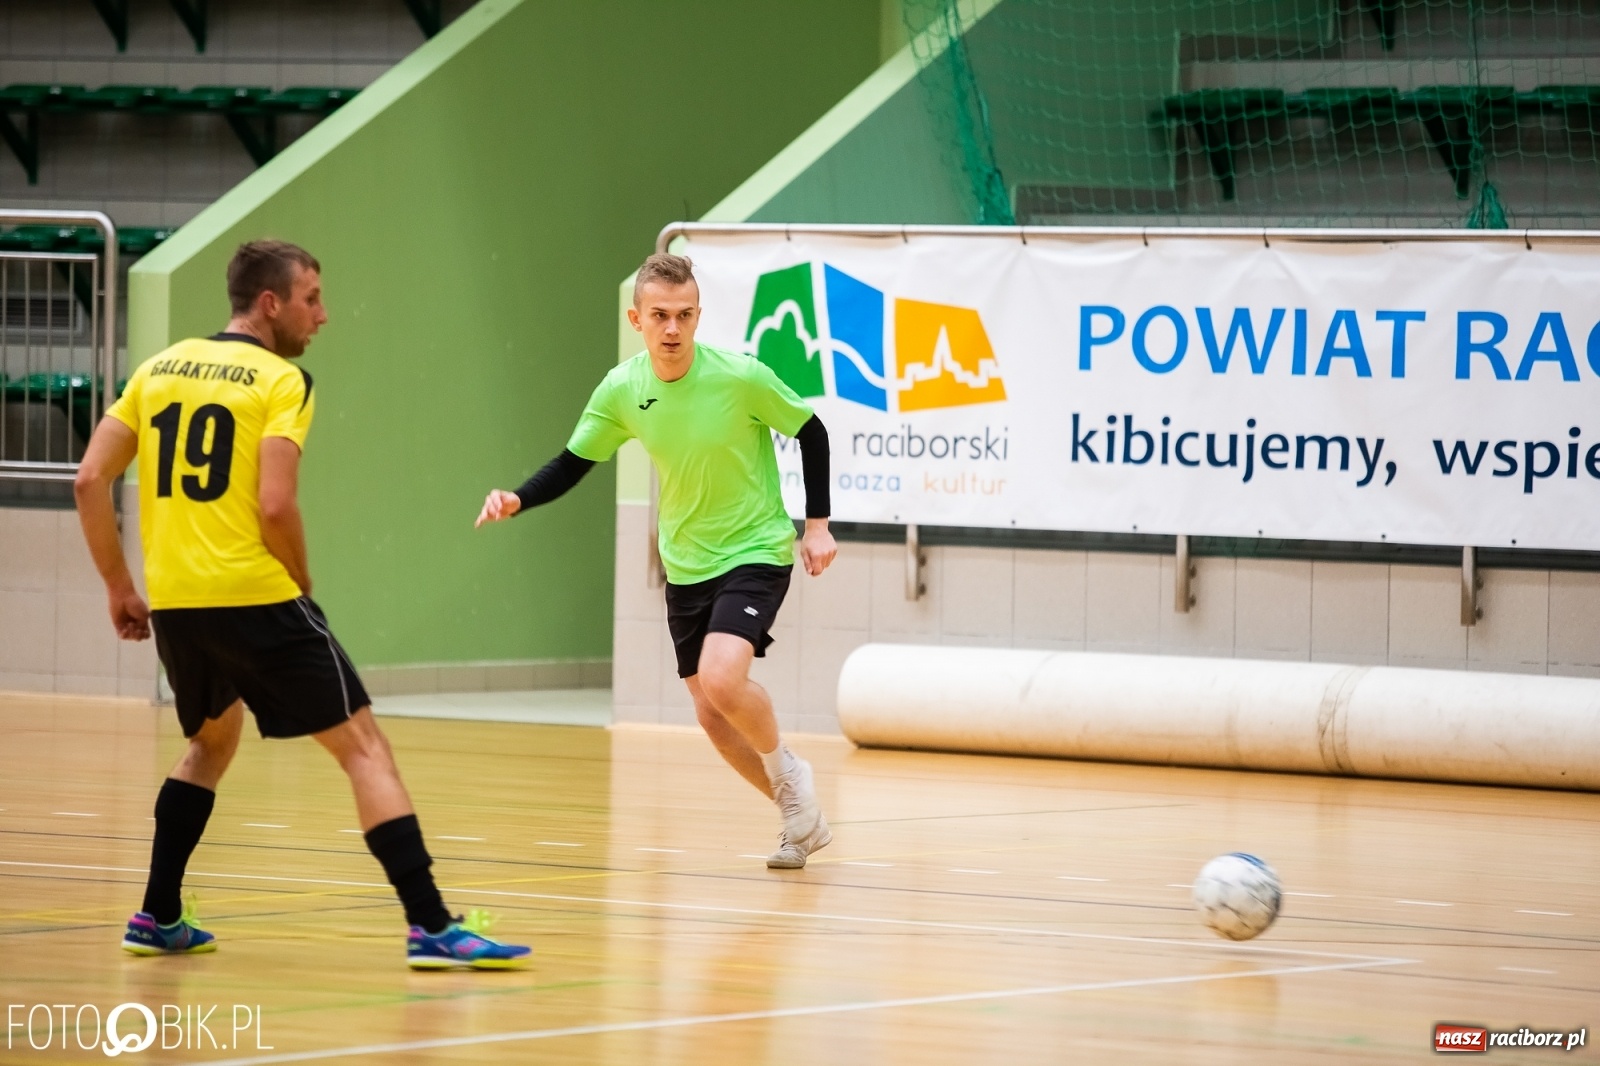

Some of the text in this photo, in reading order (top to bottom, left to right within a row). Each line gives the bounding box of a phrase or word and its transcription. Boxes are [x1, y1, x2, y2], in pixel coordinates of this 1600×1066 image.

[1078, 305, 1426, 379] POWIAT
[150, 358, 258, 386] GALAKTIKOS
[150, 402, 235, 502] 19
[853, 424, 1008, 460] raciborski
[1071, 413, 1397, 487] kibicujemy,
[838, 472, 1007, 496] oaza kultur
